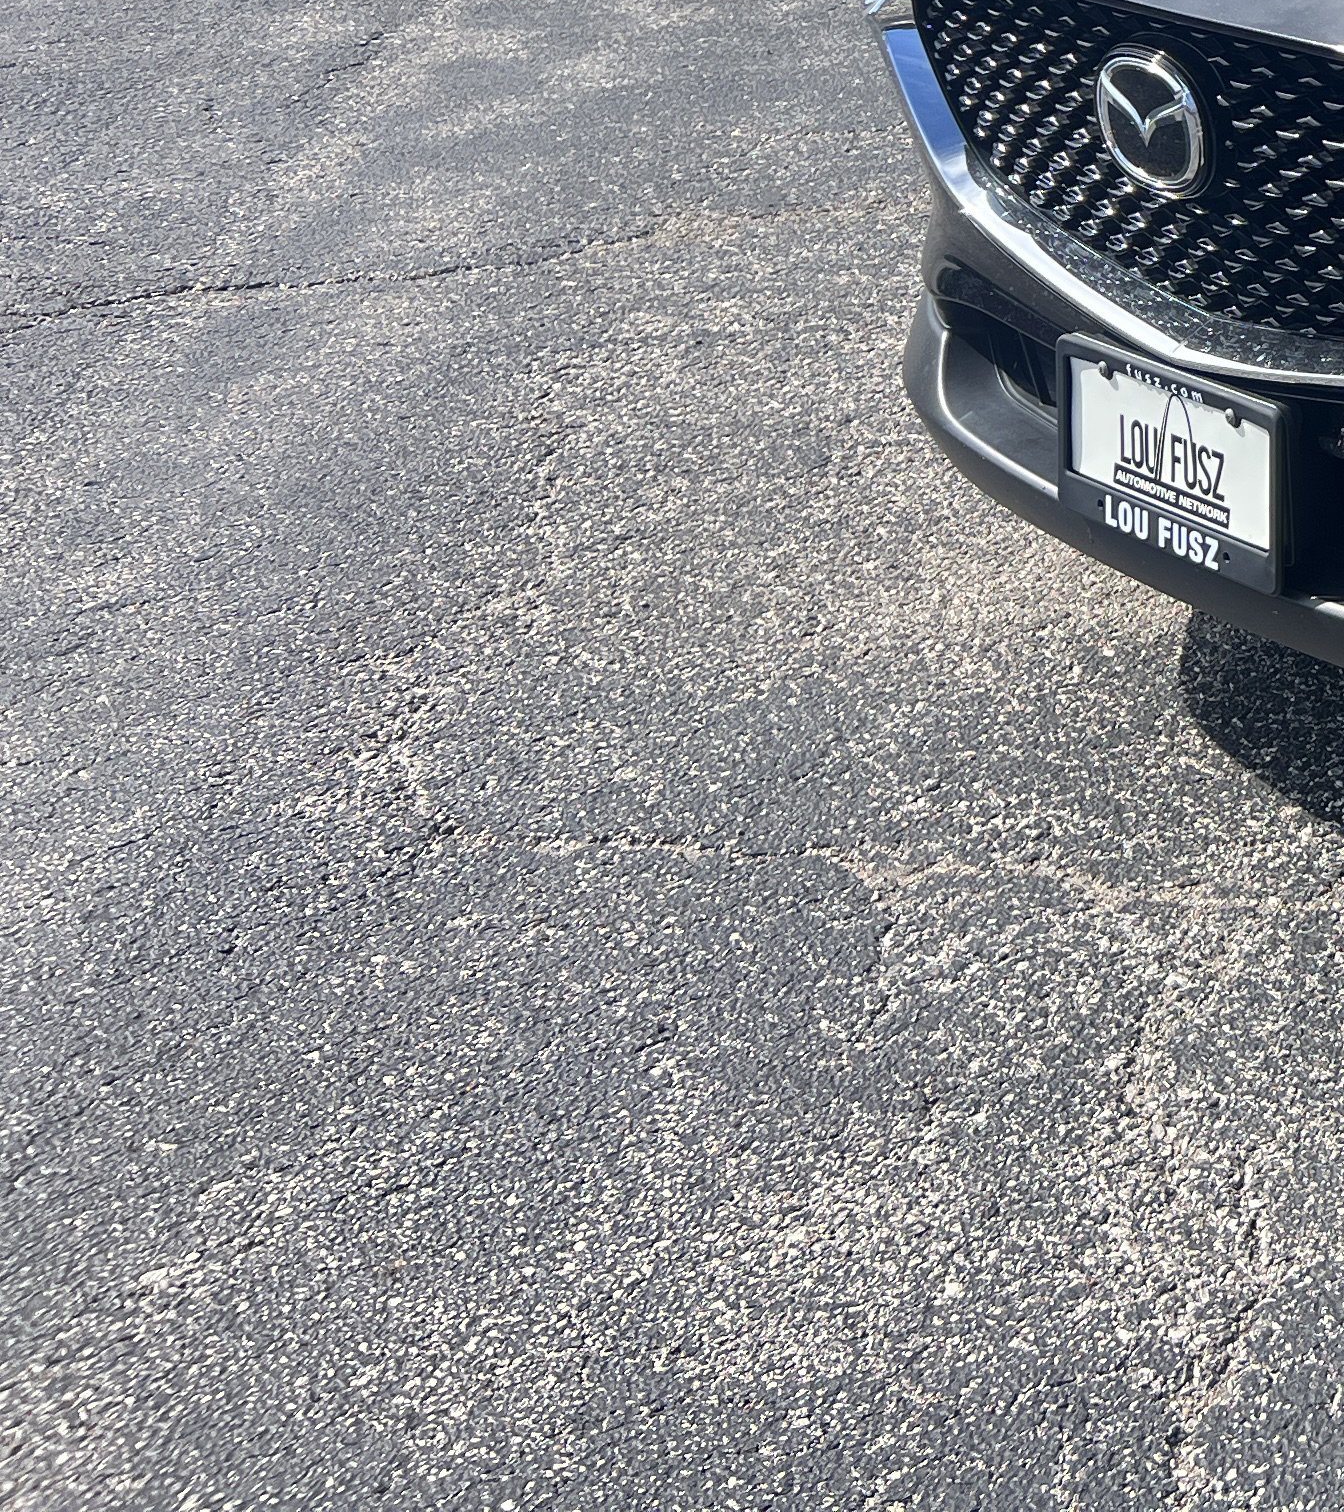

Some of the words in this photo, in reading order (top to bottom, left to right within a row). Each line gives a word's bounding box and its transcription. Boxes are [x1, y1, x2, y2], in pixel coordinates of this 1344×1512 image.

[1126, 363, 1204, 403] fusz.com
[1119, 414, 1158, 475] LOU
[1170, 433, 1225, 503] FUSZ
[1115, 469, 1177, 504] AUTOMOTIVE
[1178, 494, 1229, 524] NETWORK
[1105, 494, 1149, 541] LOU
[1158, 516, 1220, 572] FUSZ
